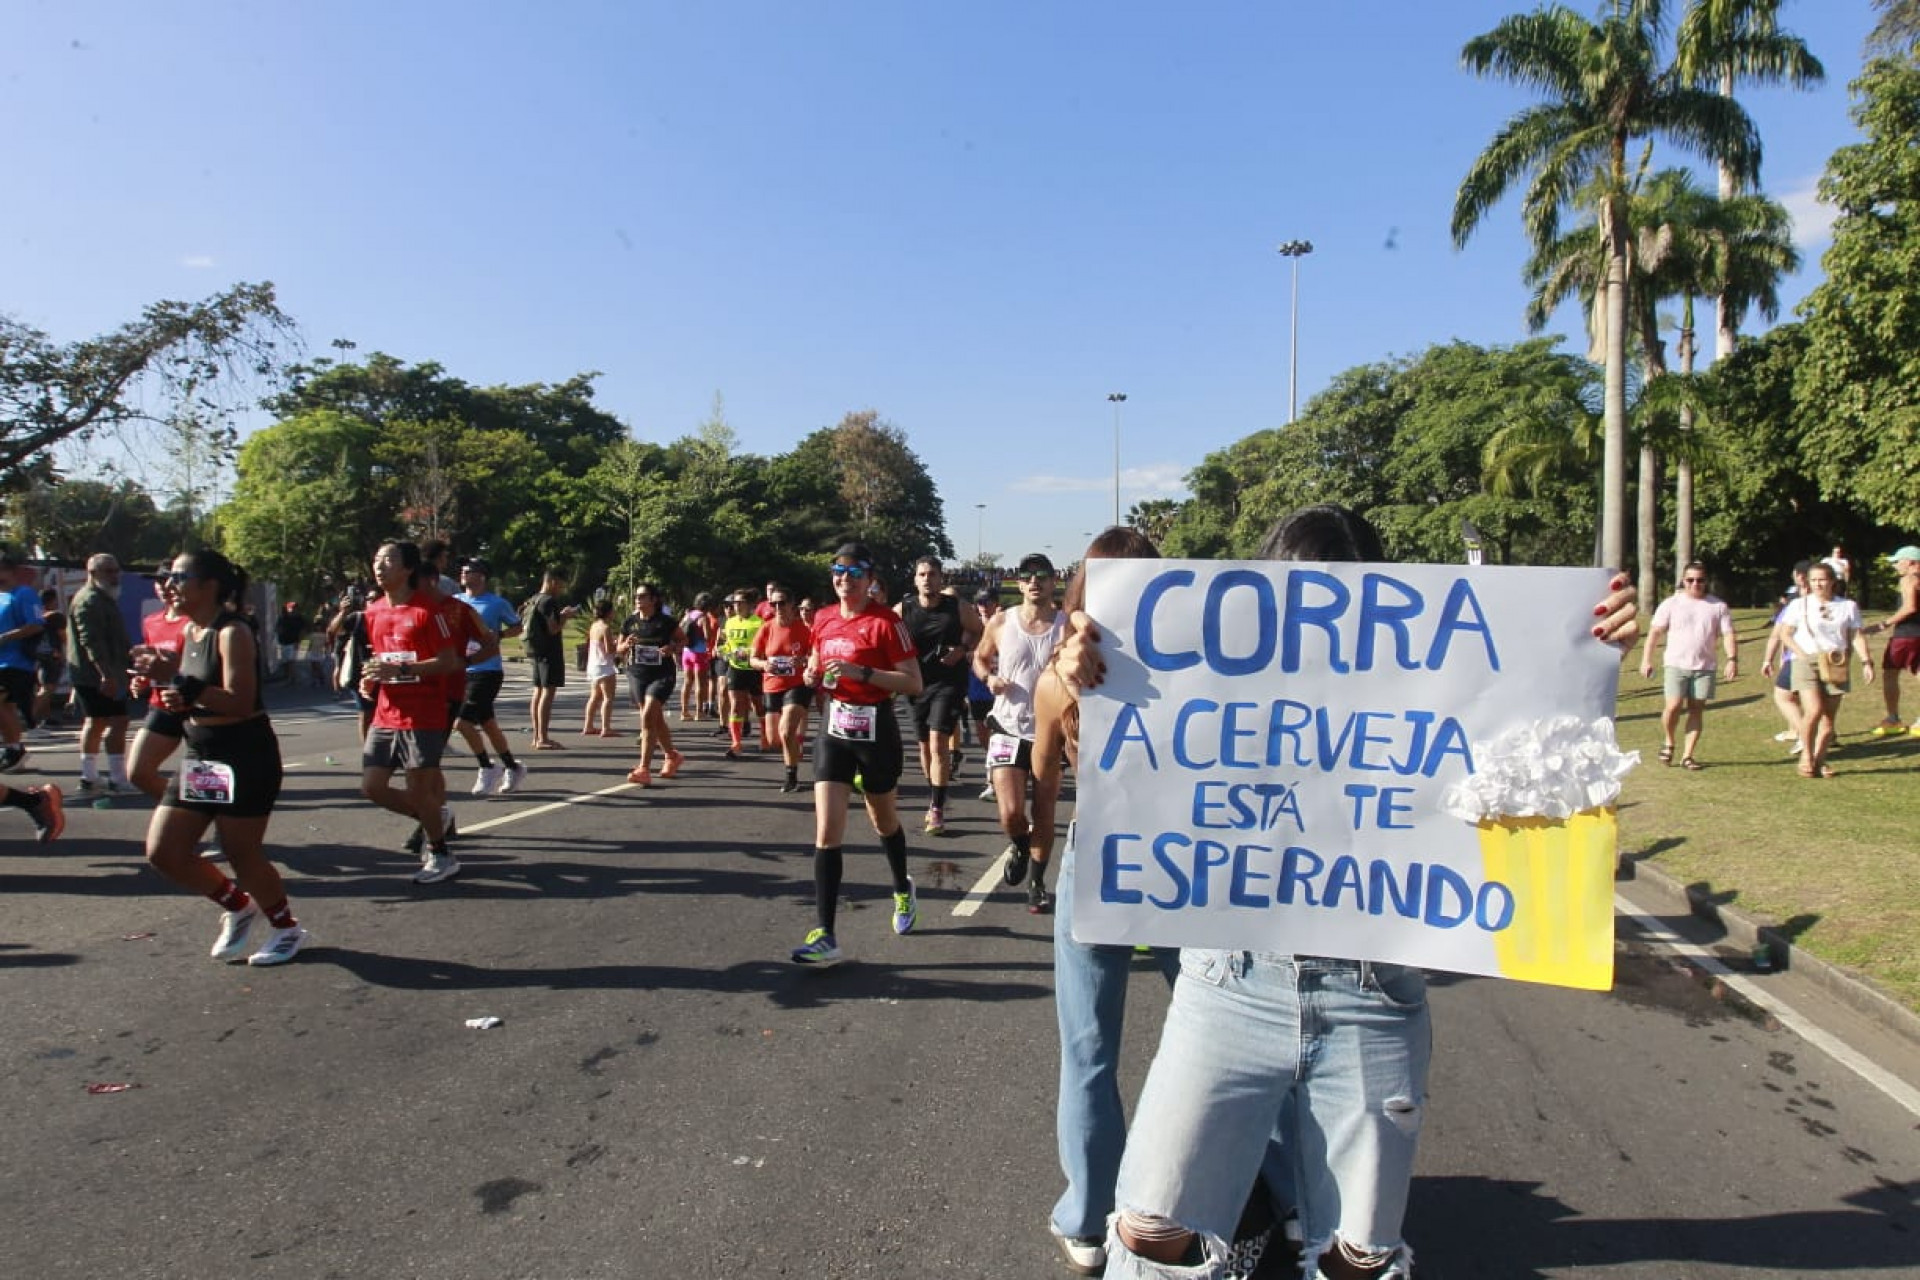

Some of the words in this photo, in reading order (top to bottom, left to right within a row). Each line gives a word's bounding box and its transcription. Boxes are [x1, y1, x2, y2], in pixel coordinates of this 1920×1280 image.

[1135, 571, 1500, 676] CORRA
[1099, 702, 1158, 771] A
[1173, 699, 1475, 778] CERVEJA
[1191, 782, 1305, 831] ESTÁ
[1345, 784, 1414, 829] TE
[1100, 832, 1515, 932] ESPERANDO
